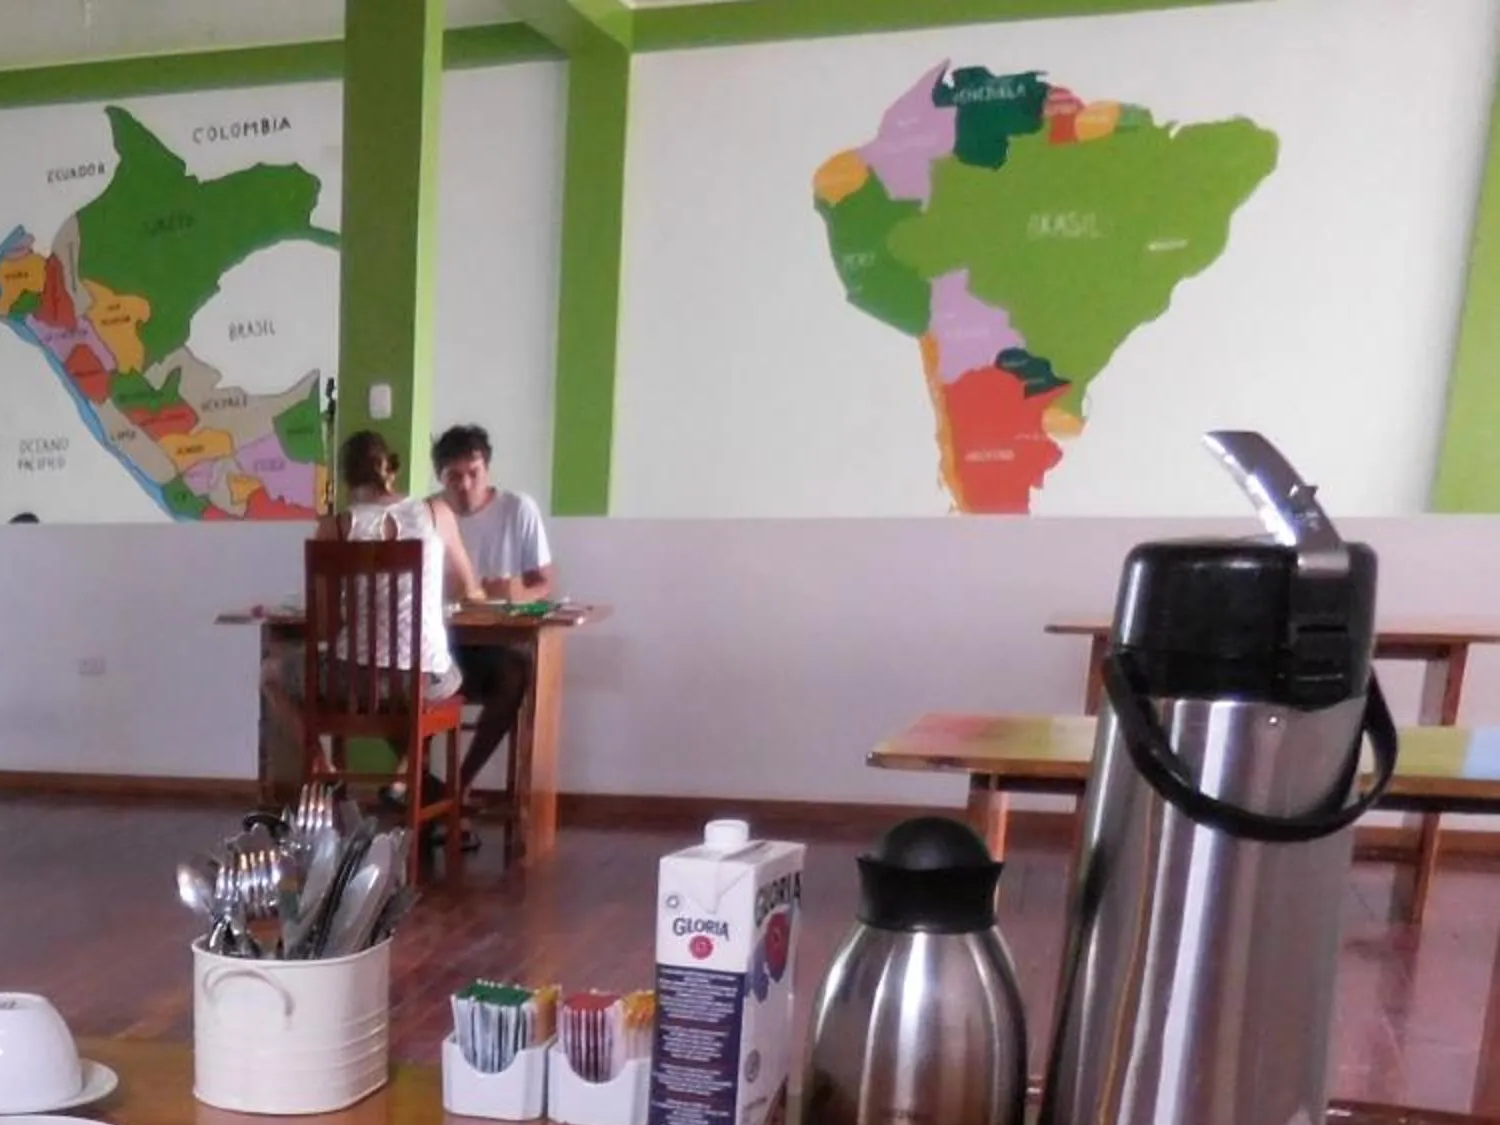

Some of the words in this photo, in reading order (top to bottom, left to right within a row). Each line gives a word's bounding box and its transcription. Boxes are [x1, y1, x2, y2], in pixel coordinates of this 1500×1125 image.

[192, 116, 292, 144] COLOMBIA
[228, 320, 277, 342] BRASIL
[672, 917, 730, 941] GLORIA
